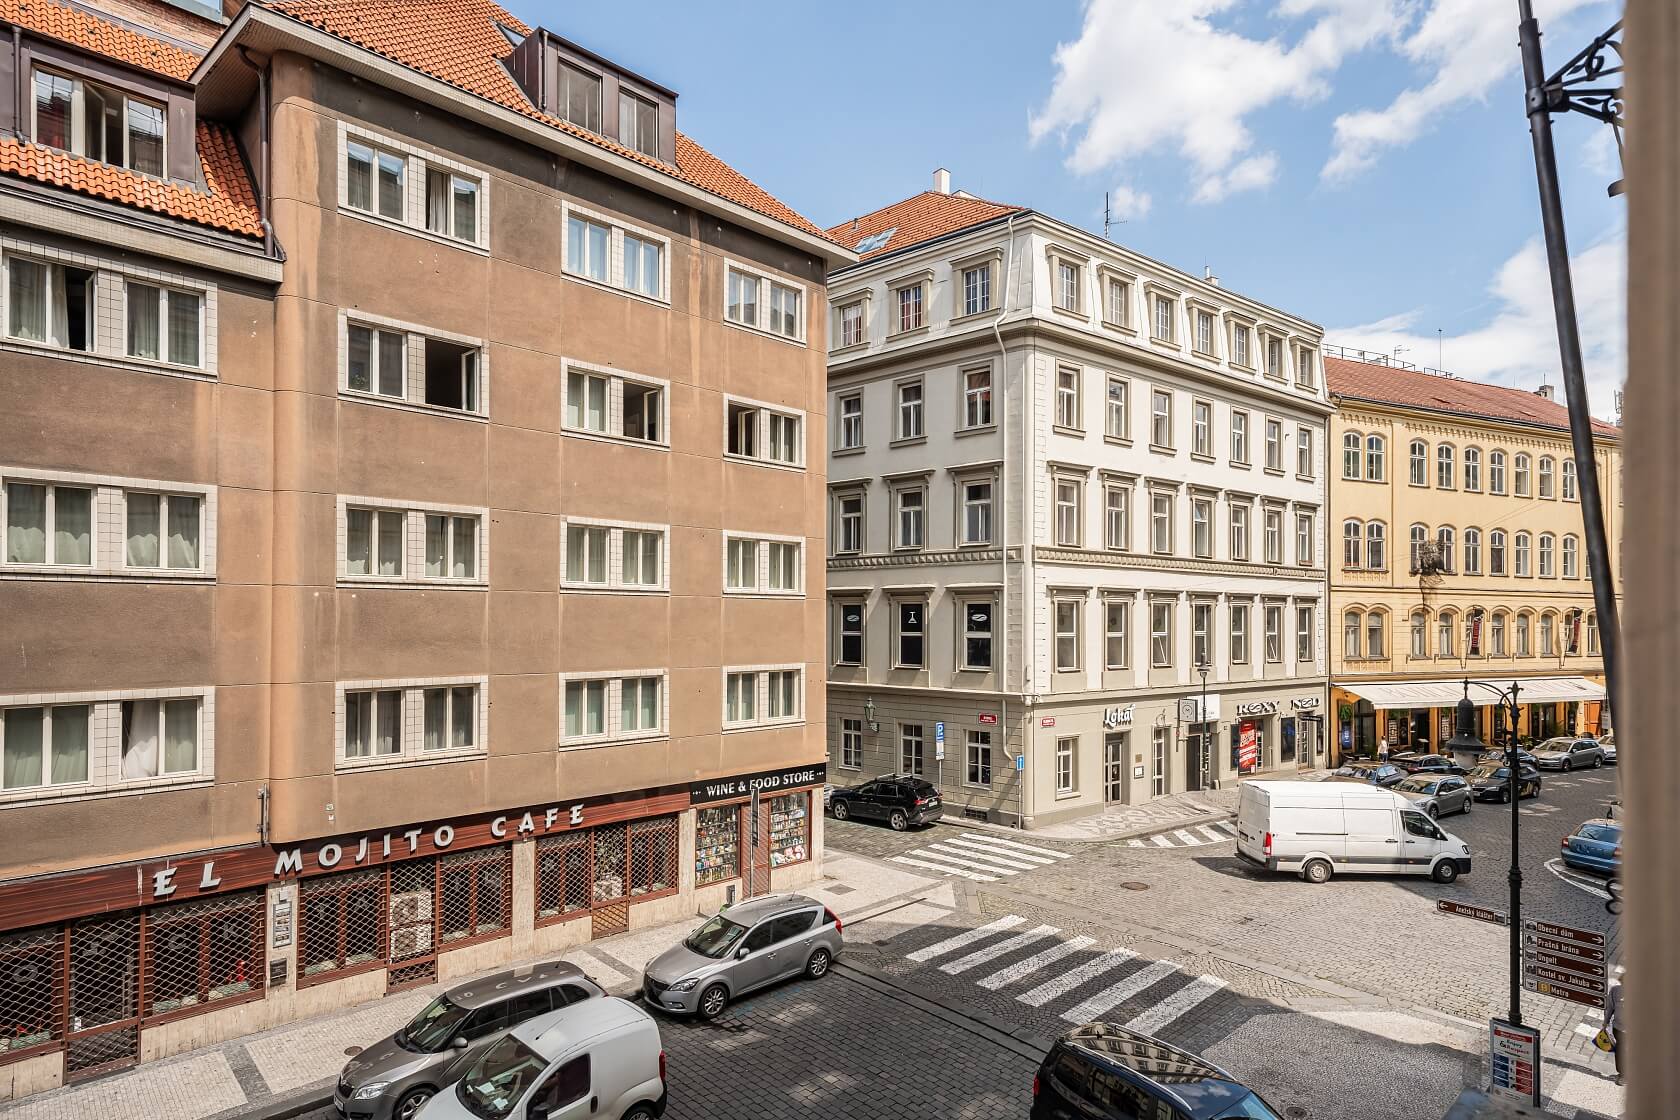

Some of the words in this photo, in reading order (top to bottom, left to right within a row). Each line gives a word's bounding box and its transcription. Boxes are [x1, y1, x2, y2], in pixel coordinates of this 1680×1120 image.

[706, 782, 735, 797] WINE
[738, 780, 746, 792] &
[750, 775, 780, 791] FOOD
[783, 770, 815, 785] STORE
[153, 861, 222, 897] EL
[274, 824, 455, 876] MOJITO
[491, 803, 585, 837] CAFE
[1537, 922, 1558, 935] Obecní
[1537, 937, 1559, 950] Prašná
[1537, 952, 1557, 965] Ungelt
[1537, 967, 1556, 979] Kostel
[1568, 975, 1590, 988] Jakuba
[1551, 986, 1569, 997] Metro
